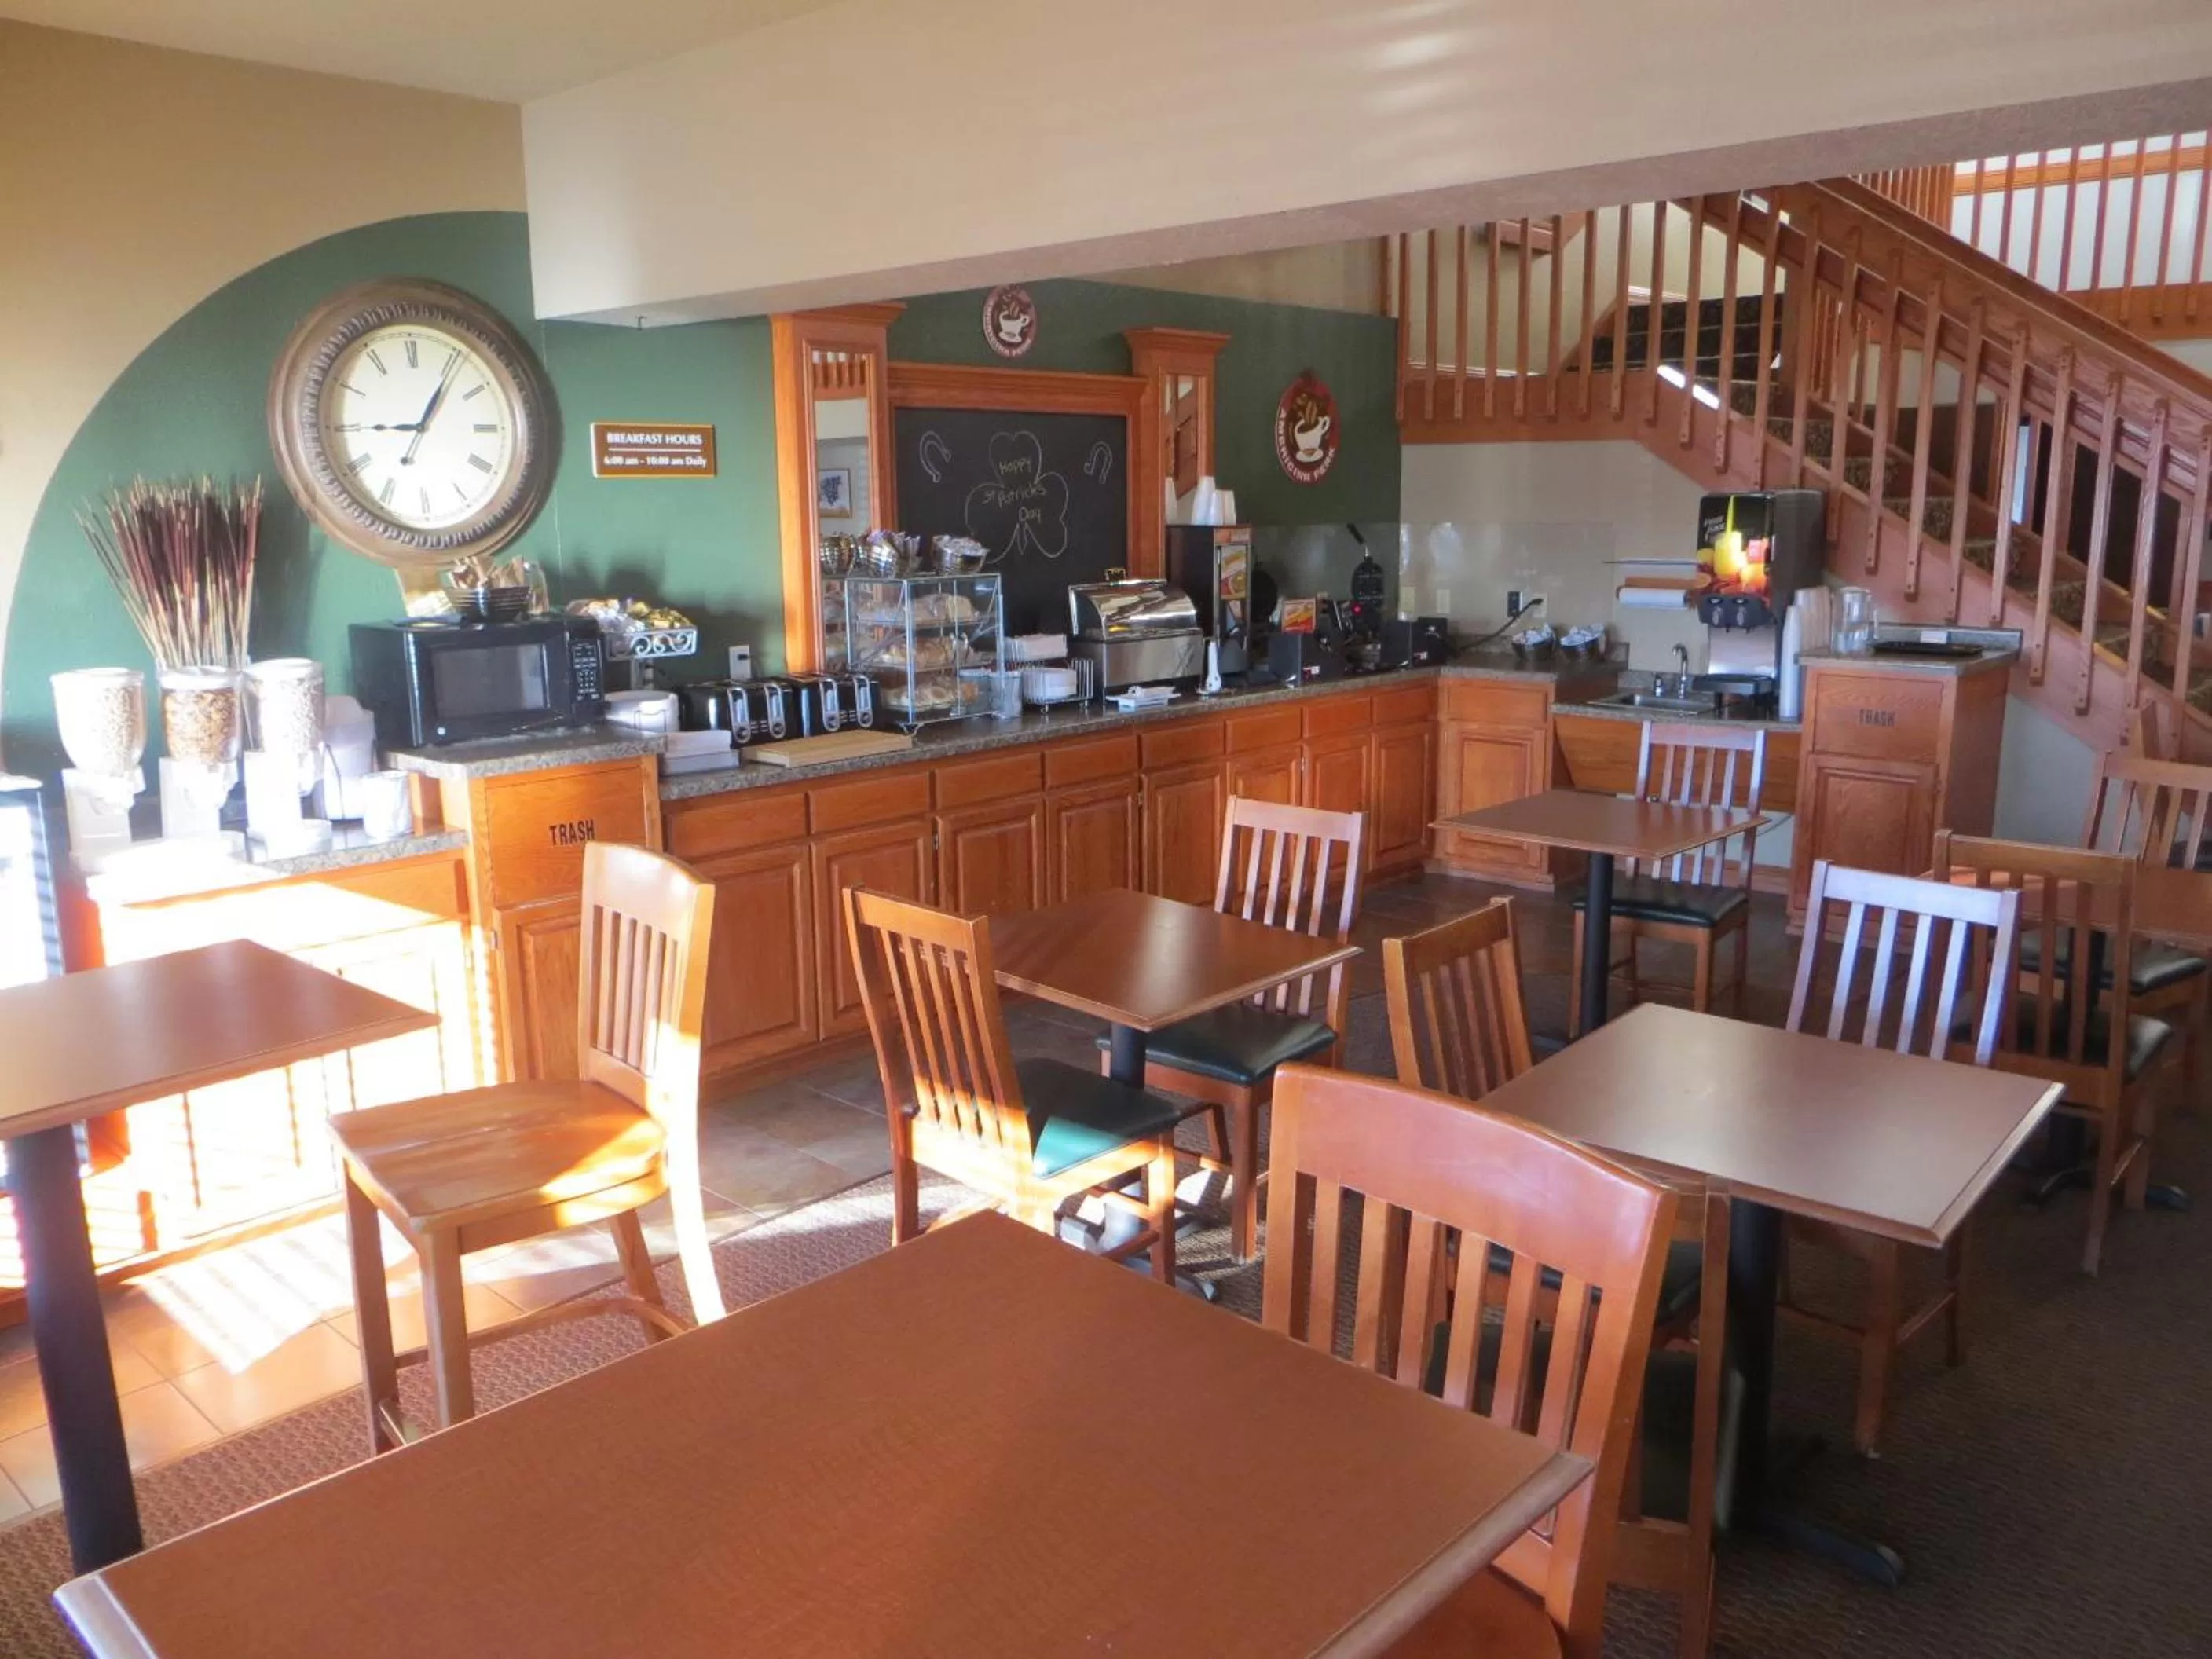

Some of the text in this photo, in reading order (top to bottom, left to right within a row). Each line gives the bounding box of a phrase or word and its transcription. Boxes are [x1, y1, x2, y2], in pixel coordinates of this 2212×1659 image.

[607, 433, 702, 445] BREAKFAST HOURS
[685, 456, 707, 468] Daily
[1859, 709, 1895, 727] TRASH
[549, 819, 595, 846] TRASH
